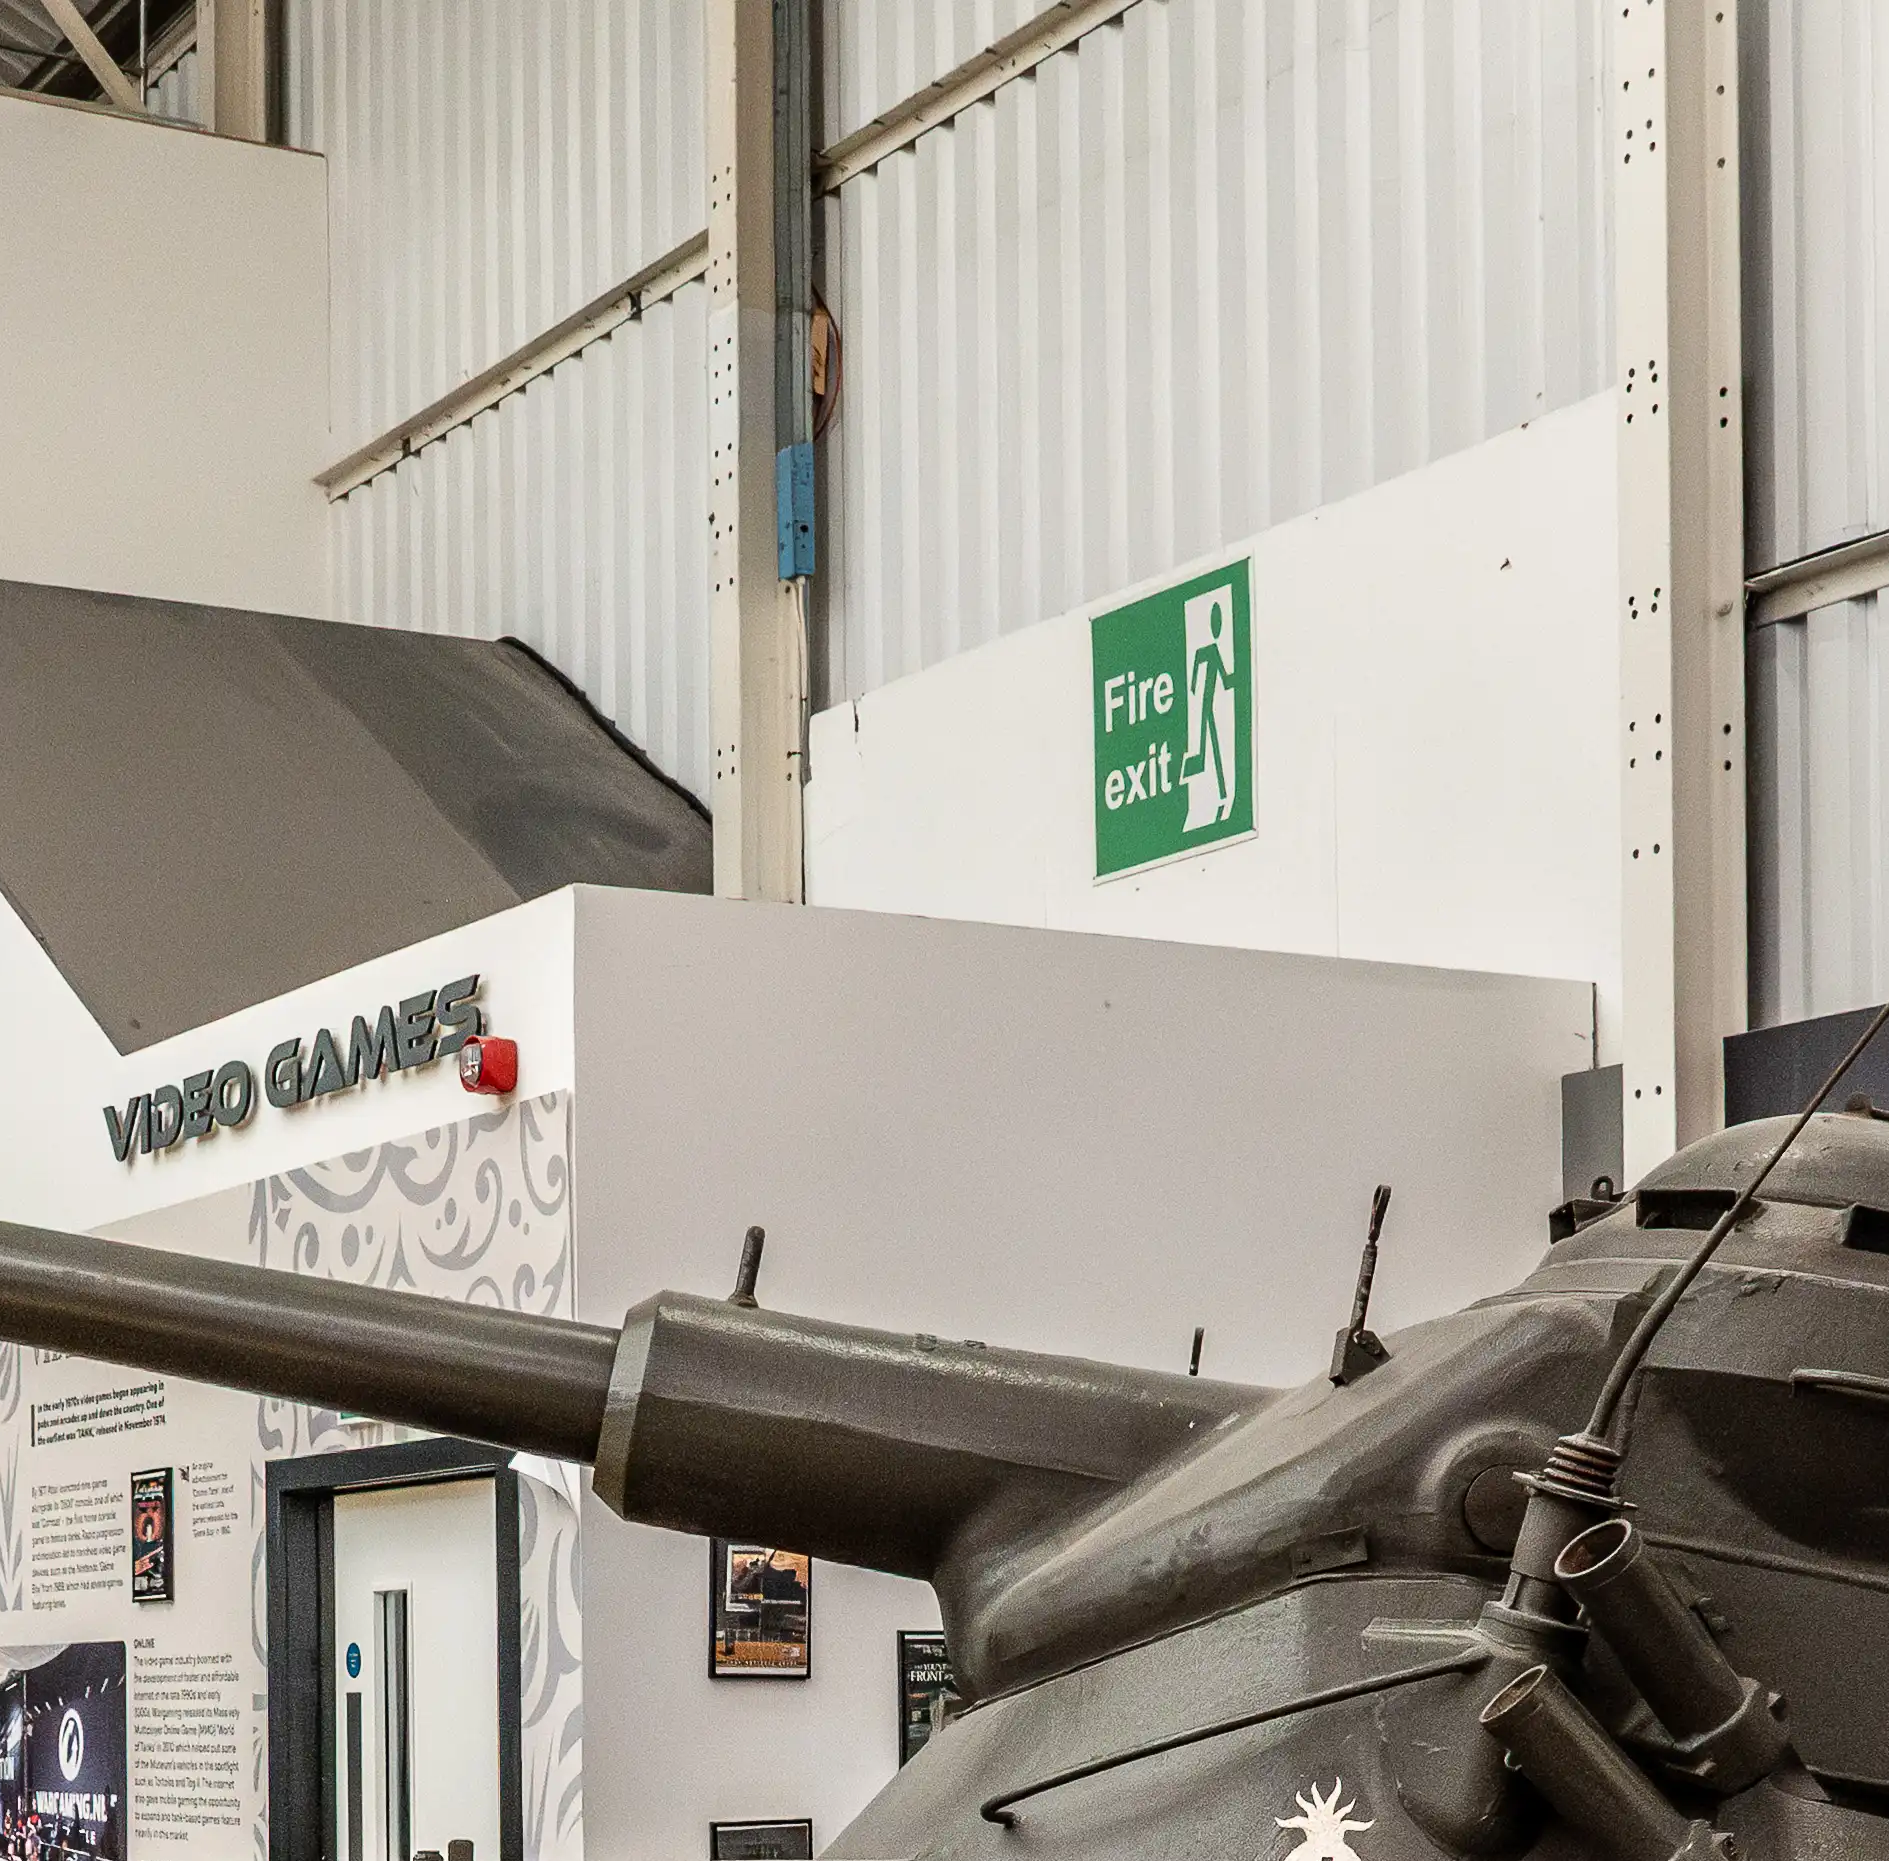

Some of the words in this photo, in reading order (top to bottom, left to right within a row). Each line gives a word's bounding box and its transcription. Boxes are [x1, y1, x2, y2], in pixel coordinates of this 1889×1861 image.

[1104, 669, 1175, 733] Fire
[1104, 742, 1173, 810] exit
[103, 1060, 253, 1163] VIDEO
[264, 974, 488, 1110] GAMES
[134, 1638, 154, 1649] ONLINE
